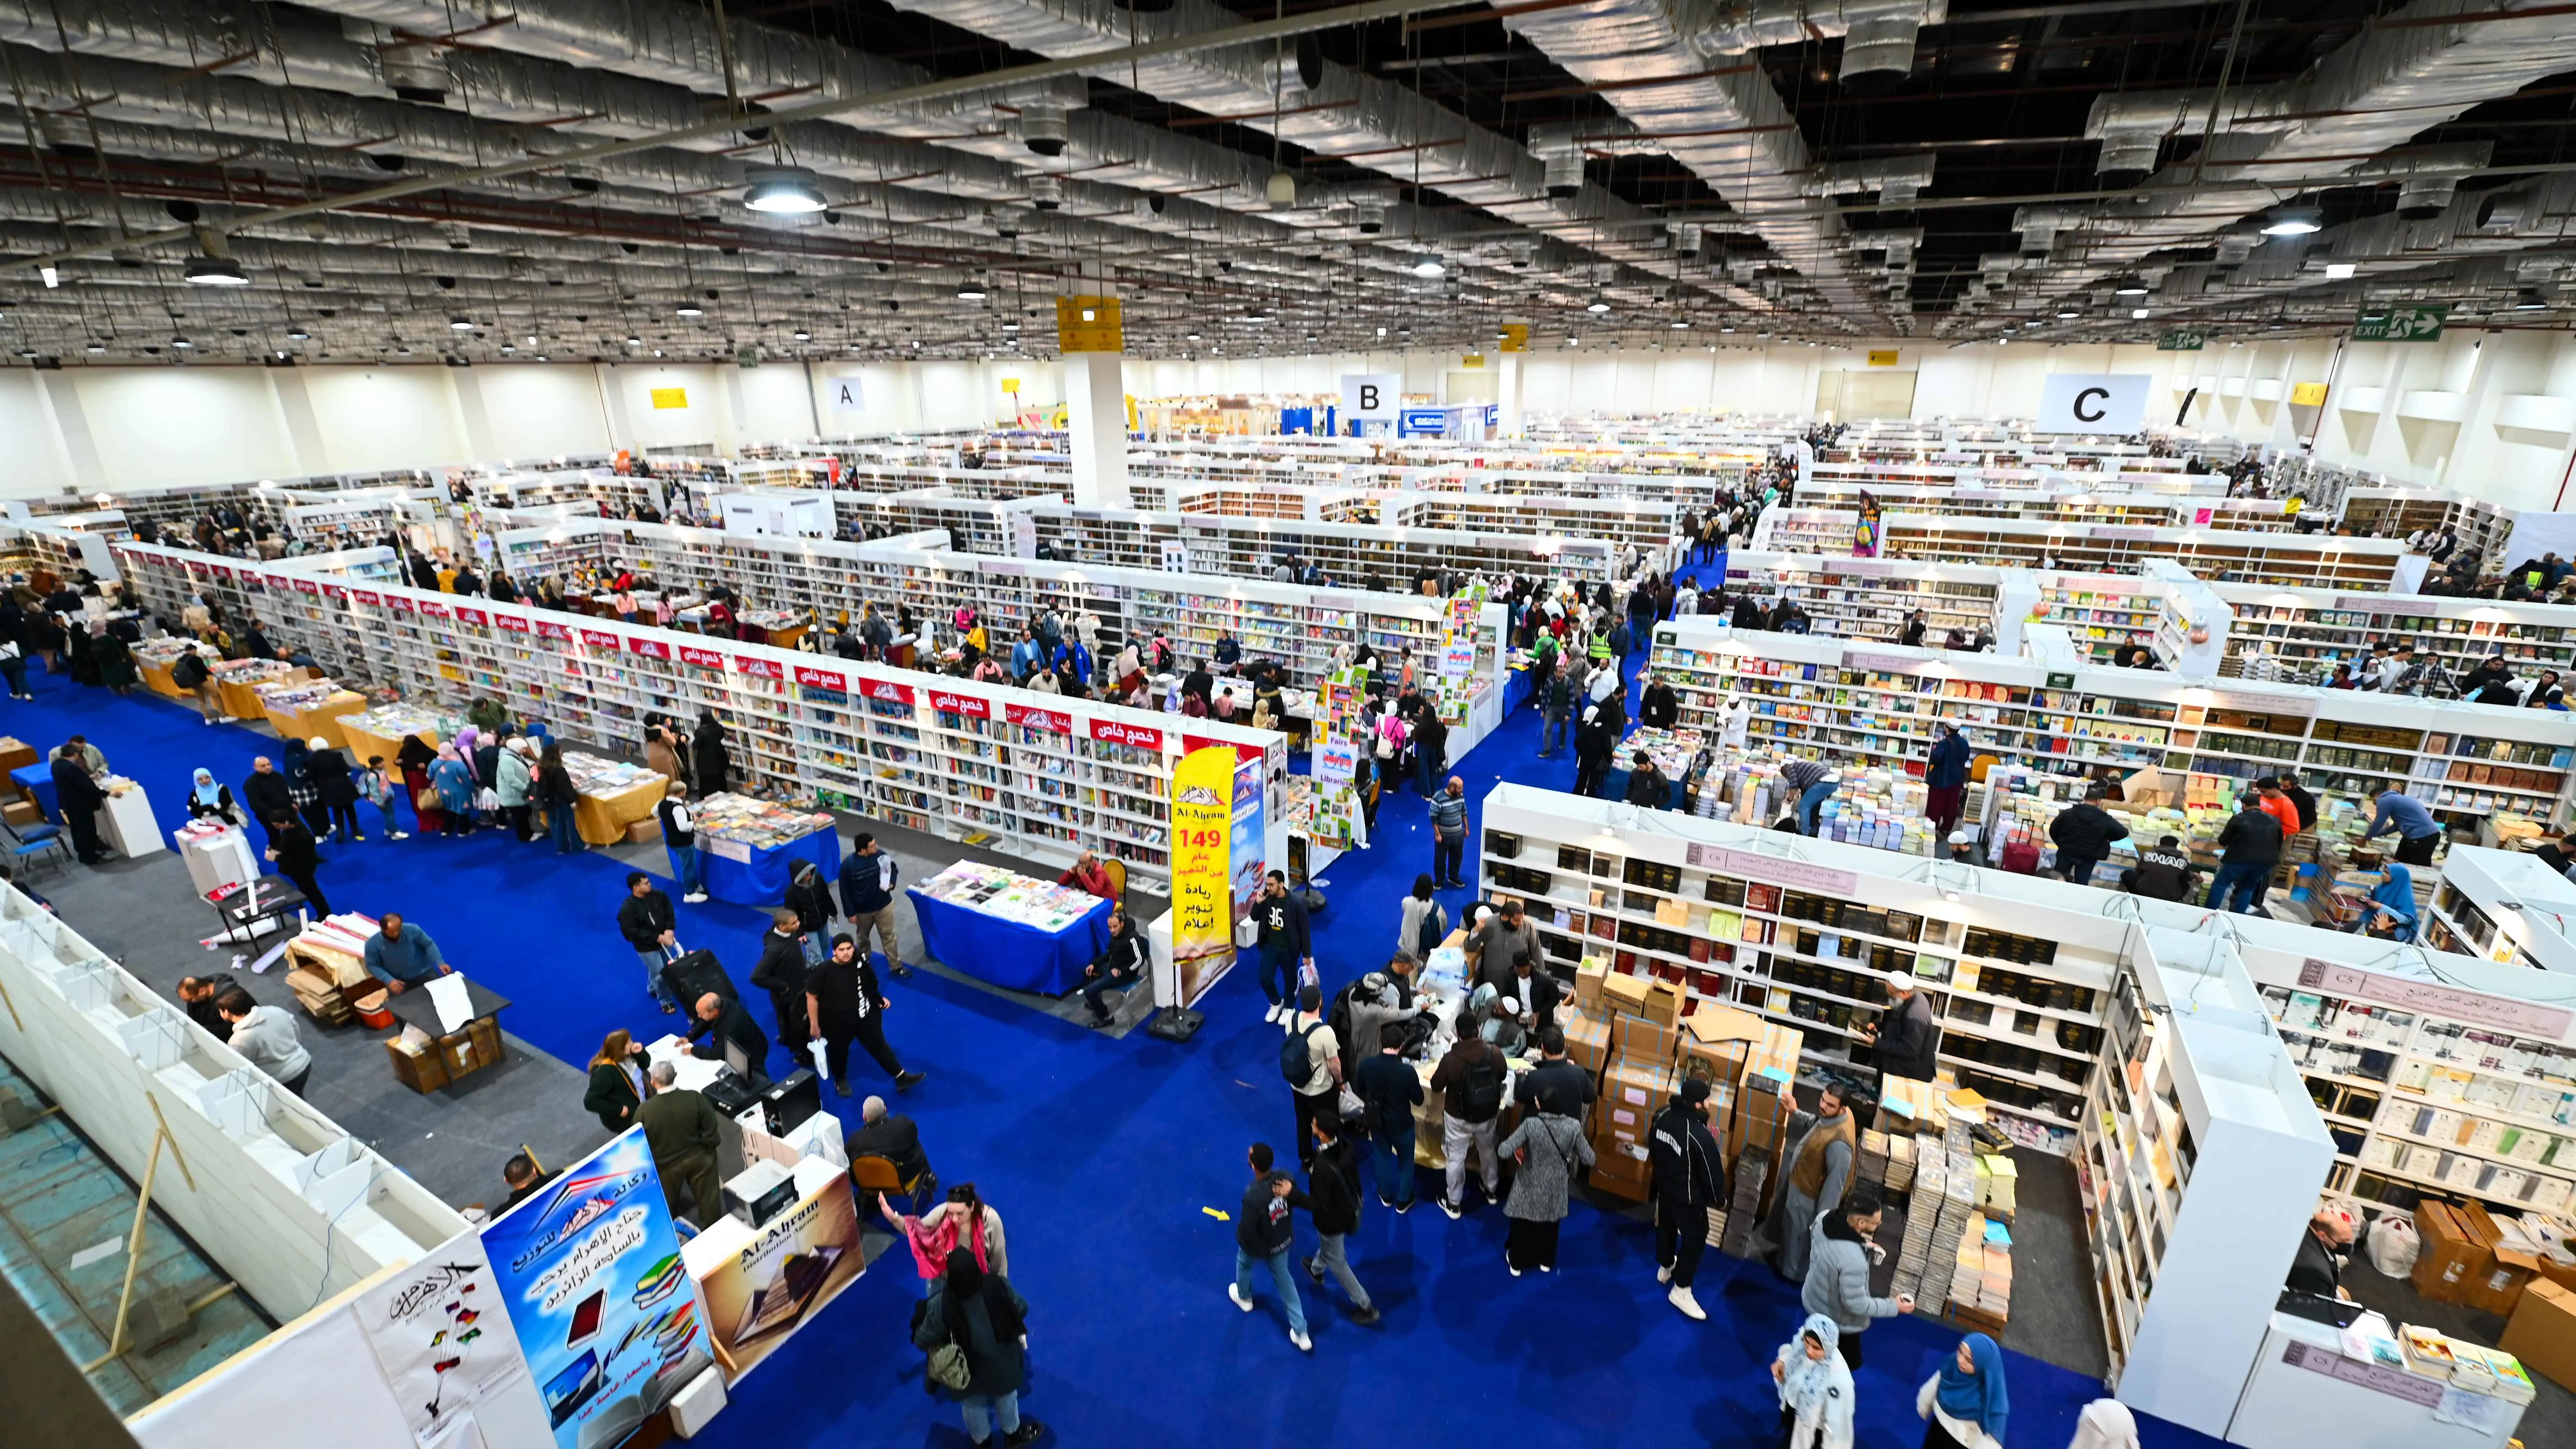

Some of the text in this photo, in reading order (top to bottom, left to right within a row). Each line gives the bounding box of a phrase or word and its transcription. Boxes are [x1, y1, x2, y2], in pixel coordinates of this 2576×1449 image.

[2355, 325, 2386, 336] EXIT
[840, 385, 853, 404] A
[1360, 385, 1379, 410] B
[2073, 387, 2110, 422] C
[585, 630, 600, 643] خاص
[600, 634, 615, 647] خصم
[684, 648, 719, 666] خصم خاص
[800, 669, 840, 687] خصم خاص
[936, 693, 983, 713] خصم خاص
[1055, 715, 1070, 728] وكالة
[1098, 723, 1155, 745] خصم خاص
[1330, 736, 1348, 746] Fairs
[1320, 774, 1351, 787] Libraries
[1177, 808, 1225, 821] Al-Ahram
[1180, 829, 1221, 848] 149
[1191, 852, 1209, 863] عام
[2143, 851, 2187, 870] SHAQ
[1177, 864, 1223, 878] من التميز
[1185, 883, 1211, 900] ريادة
[1184, 903, 1213, 914] تنوير
[1184, 916, 1214, 932] إعلام
[2336, 974, 2353, 984] C5
[1656, 1128, 1682, 1157] DAGESTAN
[612, 1172, 647, 1198] وكالة
[616, 1210, 643, 1235] جناح
[740, 1199, 819, 1266] Al-Ahram
[512, 1230, 556, 1273] للتوزيع
[743, 1212, 820, 1273] Distribution Agency
[546, 1231, 641, 1307] بالسادة الزائرين
[531, 1262, 567, 1295] يرحب
